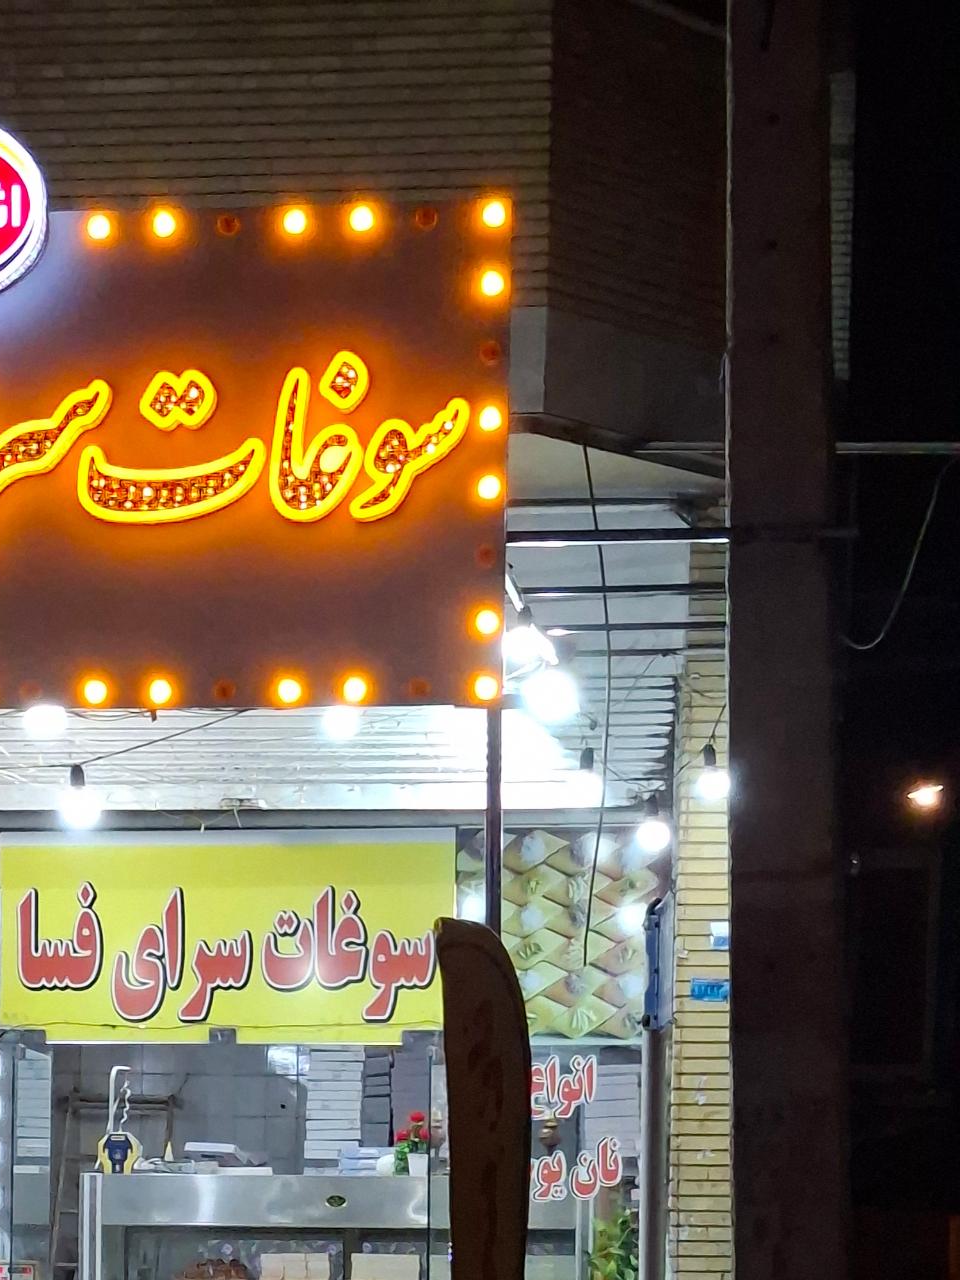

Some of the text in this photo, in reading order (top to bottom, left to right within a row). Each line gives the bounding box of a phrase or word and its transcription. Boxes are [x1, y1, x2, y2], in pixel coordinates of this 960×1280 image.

[76, 350, 470, 523] سوغات
[17, 881, 436, 1024] سوغات سرای فسا
[569, 1137, 623, 1198] نان
